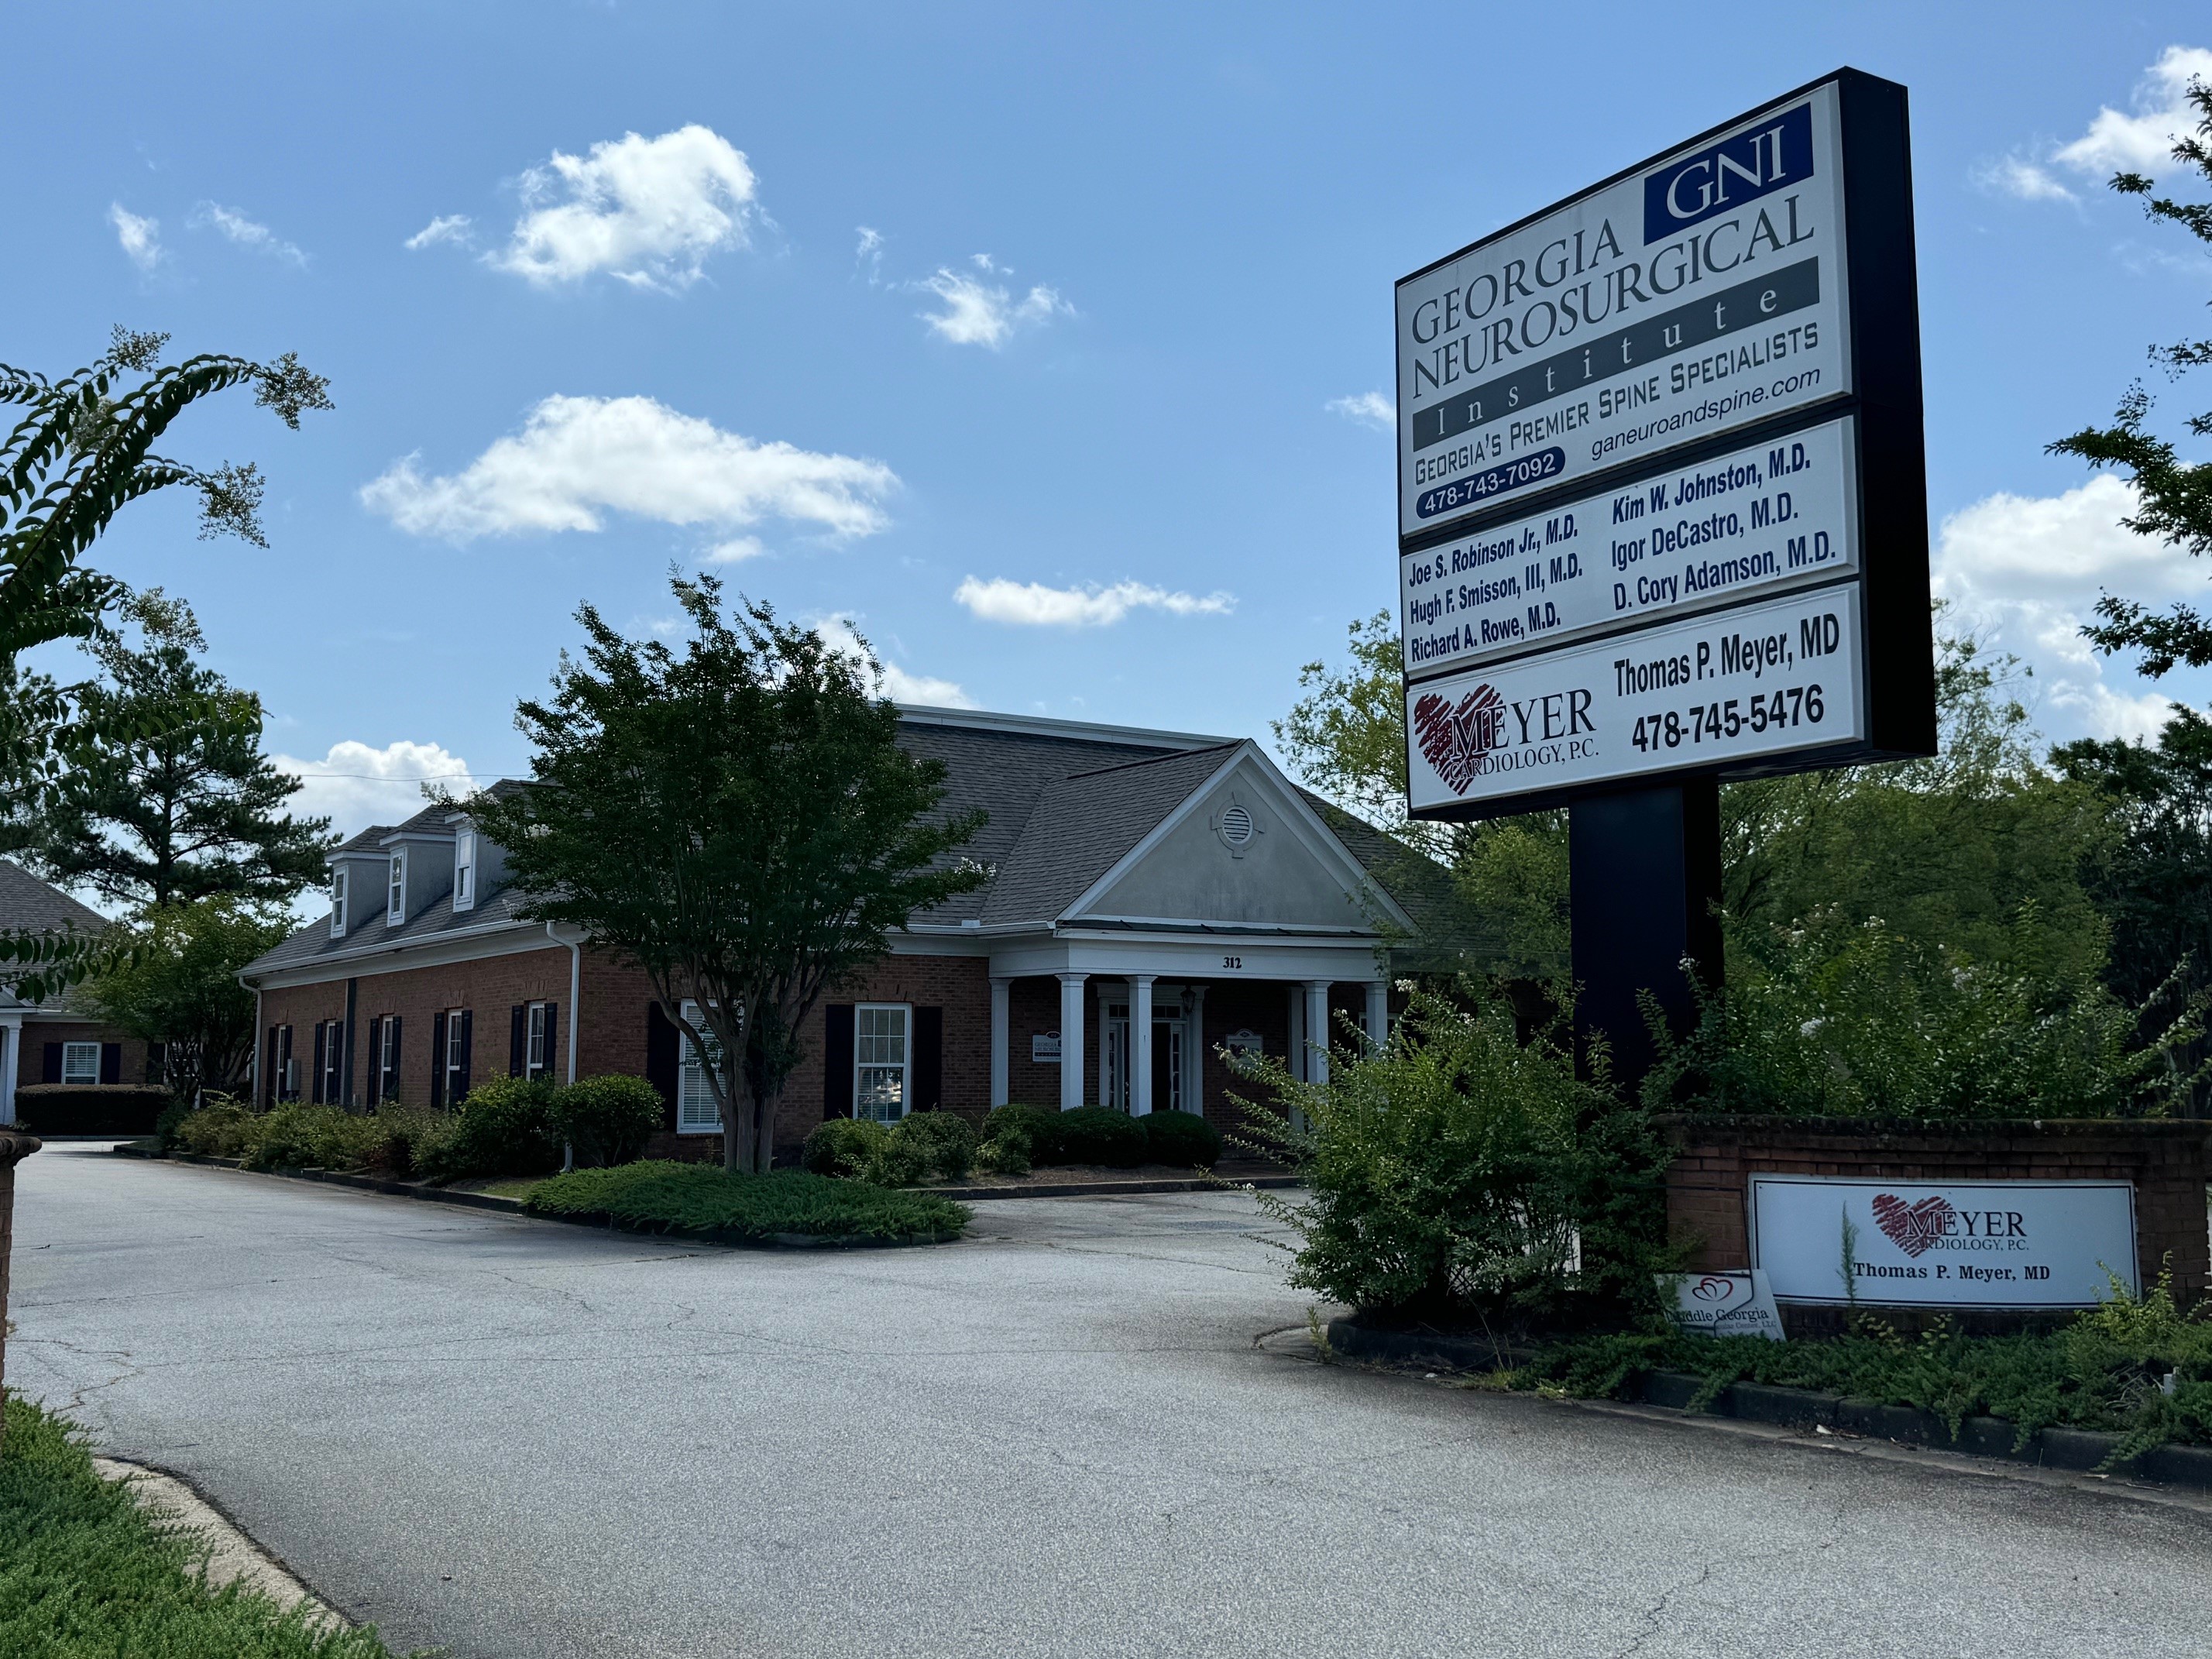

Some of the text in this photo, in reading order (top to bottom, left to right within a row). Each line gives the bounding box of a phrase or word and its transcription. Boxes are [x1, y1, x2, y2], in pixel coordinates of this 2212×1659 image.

[1667, 125, 1786, 218] GNI
[1413, 218, 1623, 344] GEORGIA
[1413, 195, 1814, 398] NEUROSURGICAL
[1437, 286, 1777, 434] Institute
[1416, 322, 1819, 485] GEORGIA'S PREMIER SPINE SPECIALISTS
[1592, 369, 1820, 461] ganeuroandspine.com
[1424, 453, 1556, 512] 478-743-7092
[1613, 442, 1811, 524] Kim W. Johnston, M.D.
[1409, 514, 1578, 587] Joe S. Robinson Jr., M.D.
[1612, 492, 1798, 570] Igor DeCastro, M.D.
[1410, 552, 1582, 626] Hugh F. Smisson, III, M.D.
[1613, 531, 1836, 610] D. Cory Adamson, M.D.
[1411, 601, 1561, 662] Richard A. Rowe, M.D.
[1614, 613, 1839, 696] Thomas P. Meyer, MD
[1450, 689, 1596, 758] MEYER
[1632, 683, 1823, 753] 478-745-5476
[1449, 738, 1599, 781] CARDIOLOGY, P.C.
[1223, 957, 1242, 969] 312
[1905, 1210, 2028, 1237] MEYER
[2008, 1239, 2029, 1250] P.C.
[1853, 1262, 2049, 1282] Thomas P. Meyer, MD
[1716, 1307, 1768, 1322] Georgia
